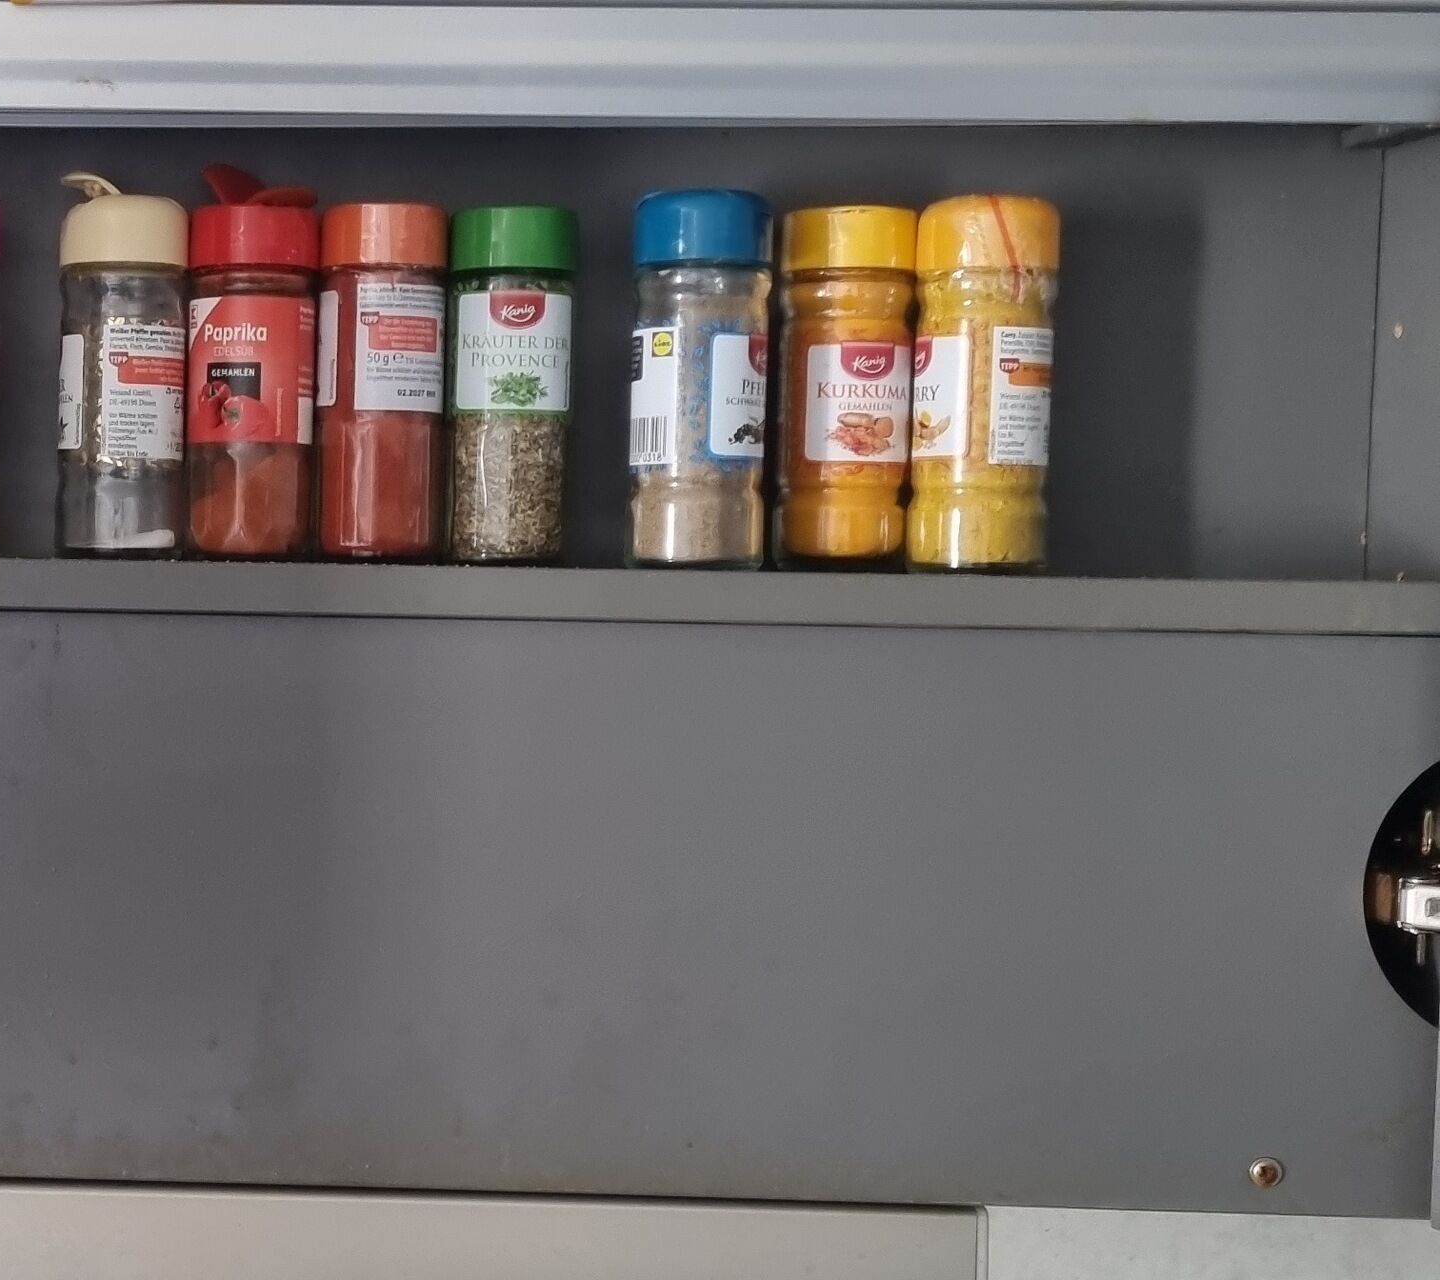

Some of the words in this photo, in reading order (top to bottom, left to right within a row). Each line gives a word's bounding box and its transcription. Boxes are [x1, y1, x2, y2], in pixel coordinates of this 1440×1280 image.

[205, 322, 268, 345] Paprika
[462, 331, 539, 350] KRÄUTER
[367, 352, 381, 364] 50
[383, 354, 389, 366] g
[472, 353, 559, 368] PROVENCE
[211, 367, 255, 377] GEMAHLEN
[817, 382, 907, 400] KURKUMA
[839, 402, 893, 411] GEMAHLEN
